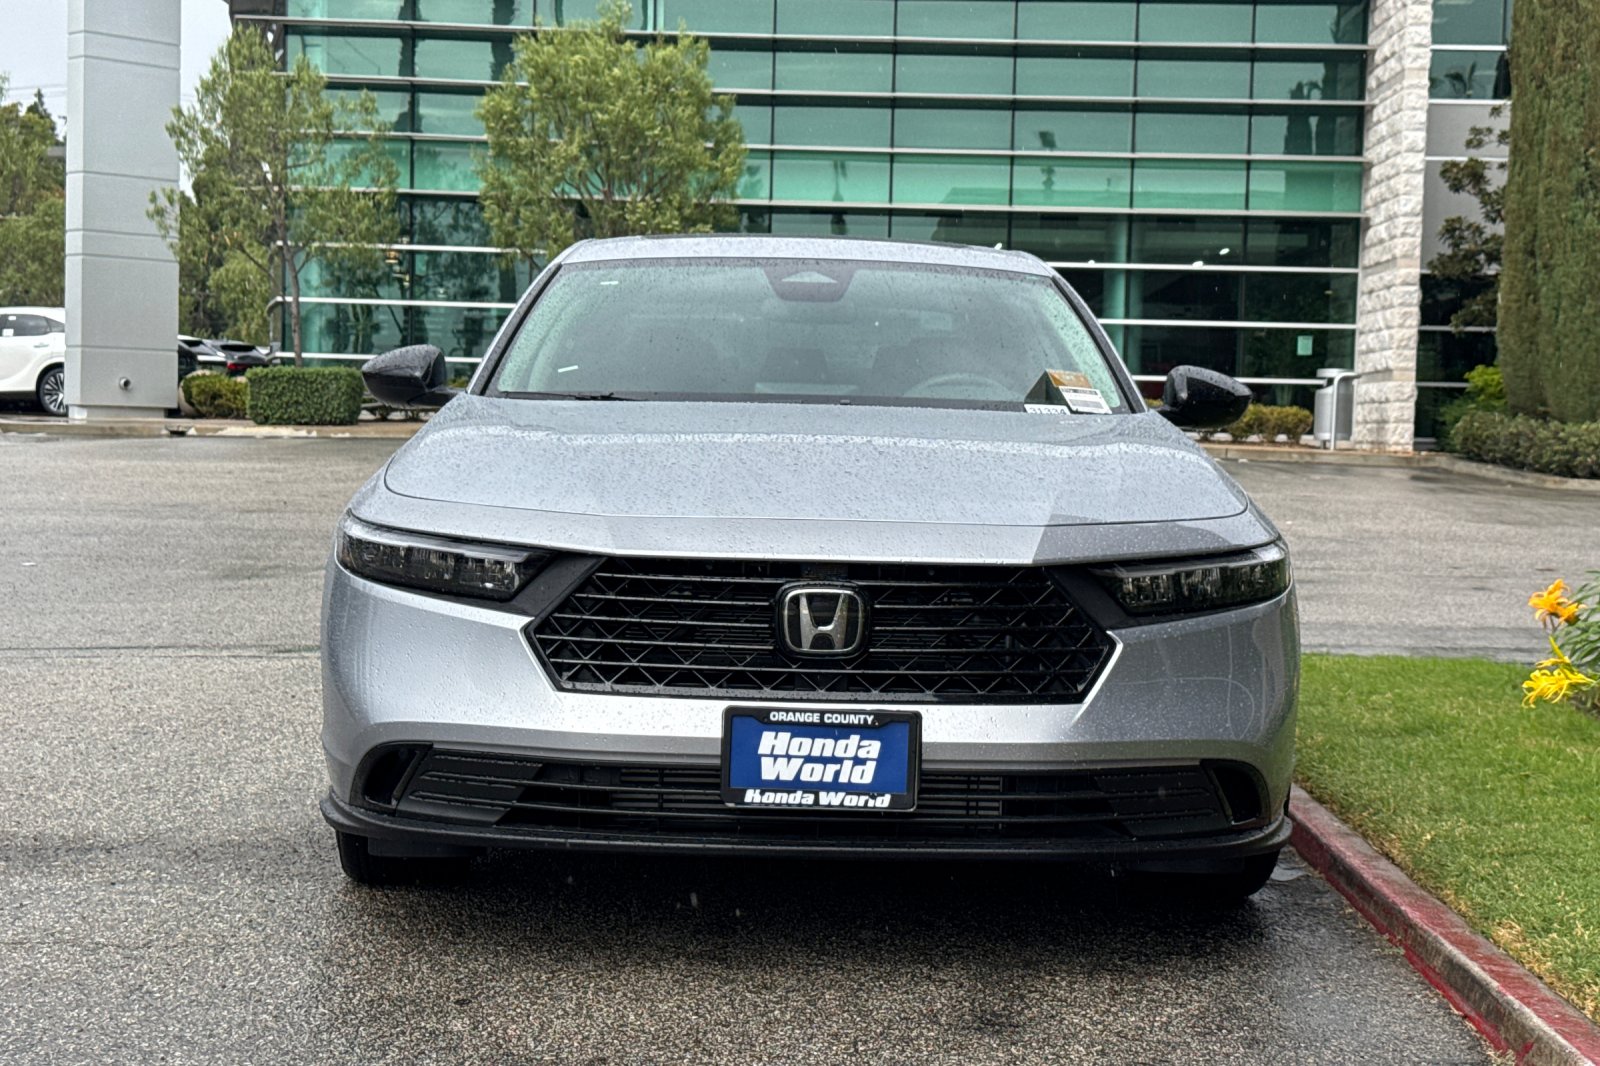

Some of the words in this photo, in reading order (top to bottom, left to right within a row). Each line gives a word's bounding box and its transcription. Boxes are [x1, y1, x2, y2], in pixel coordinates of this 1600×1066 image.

[769, 711, 820, 723] ORANGE
[824, 712, 874, 725] COUNTY
[758, 731, 881, 759] Honda
[760, 756, 877, 784] World
[744, 789, 814, 805] Honda
